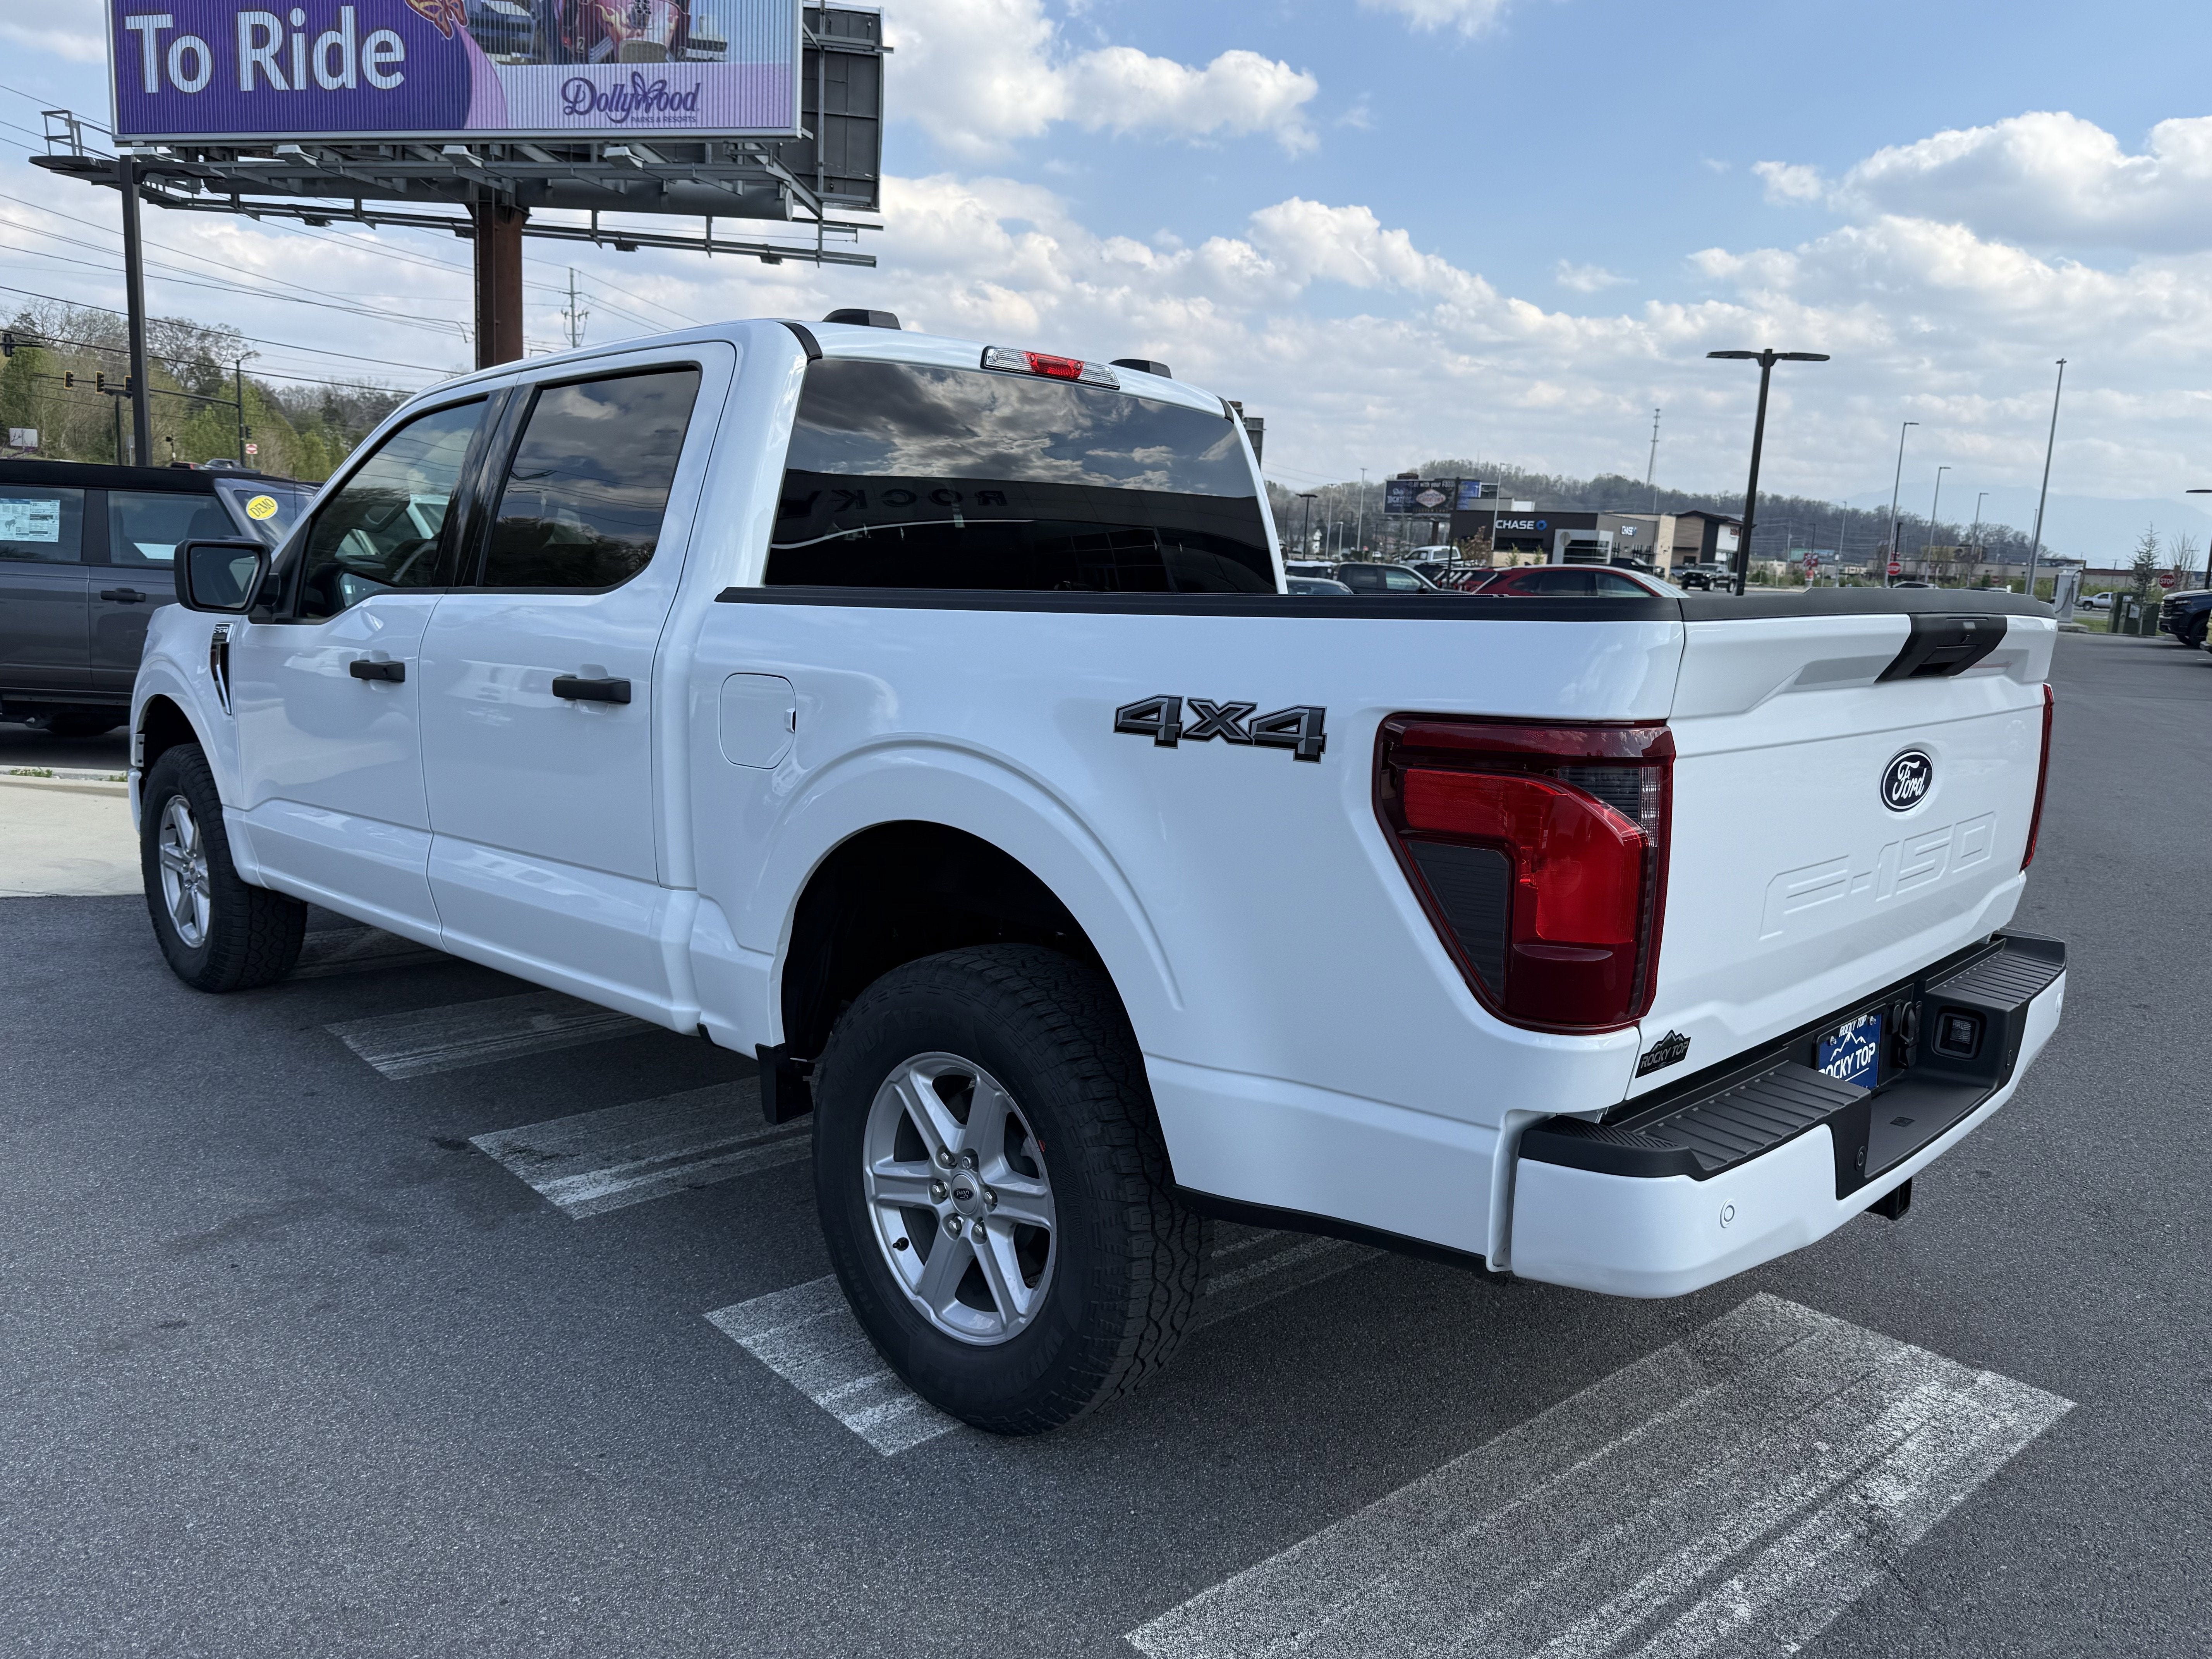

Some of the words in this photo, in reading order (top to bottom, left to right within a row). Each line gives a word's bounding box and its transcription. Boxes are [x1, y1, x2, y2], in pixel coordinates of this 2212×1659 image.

[125, 14, 211, 93] To
[237, 5, 405, 91] Ride
[250, 498, 275, 517] DEMO
[1495, 520, 1534, 529] CHASE
[1892, 761, 1927, 801] Ford
[1759, 811, 1997, 940] F-150
[1839, 1019, 1857, 1037] ROCKY
[1857, 1014, 1867, 1029] TOP
[1640, 1047, 1672, 1069] ROCKY
[1672, 1041, 1689, 1057] TOP
[1856, 1042, 1876, 1070] TOP
[957, 1190, 969, 1199] Ford
